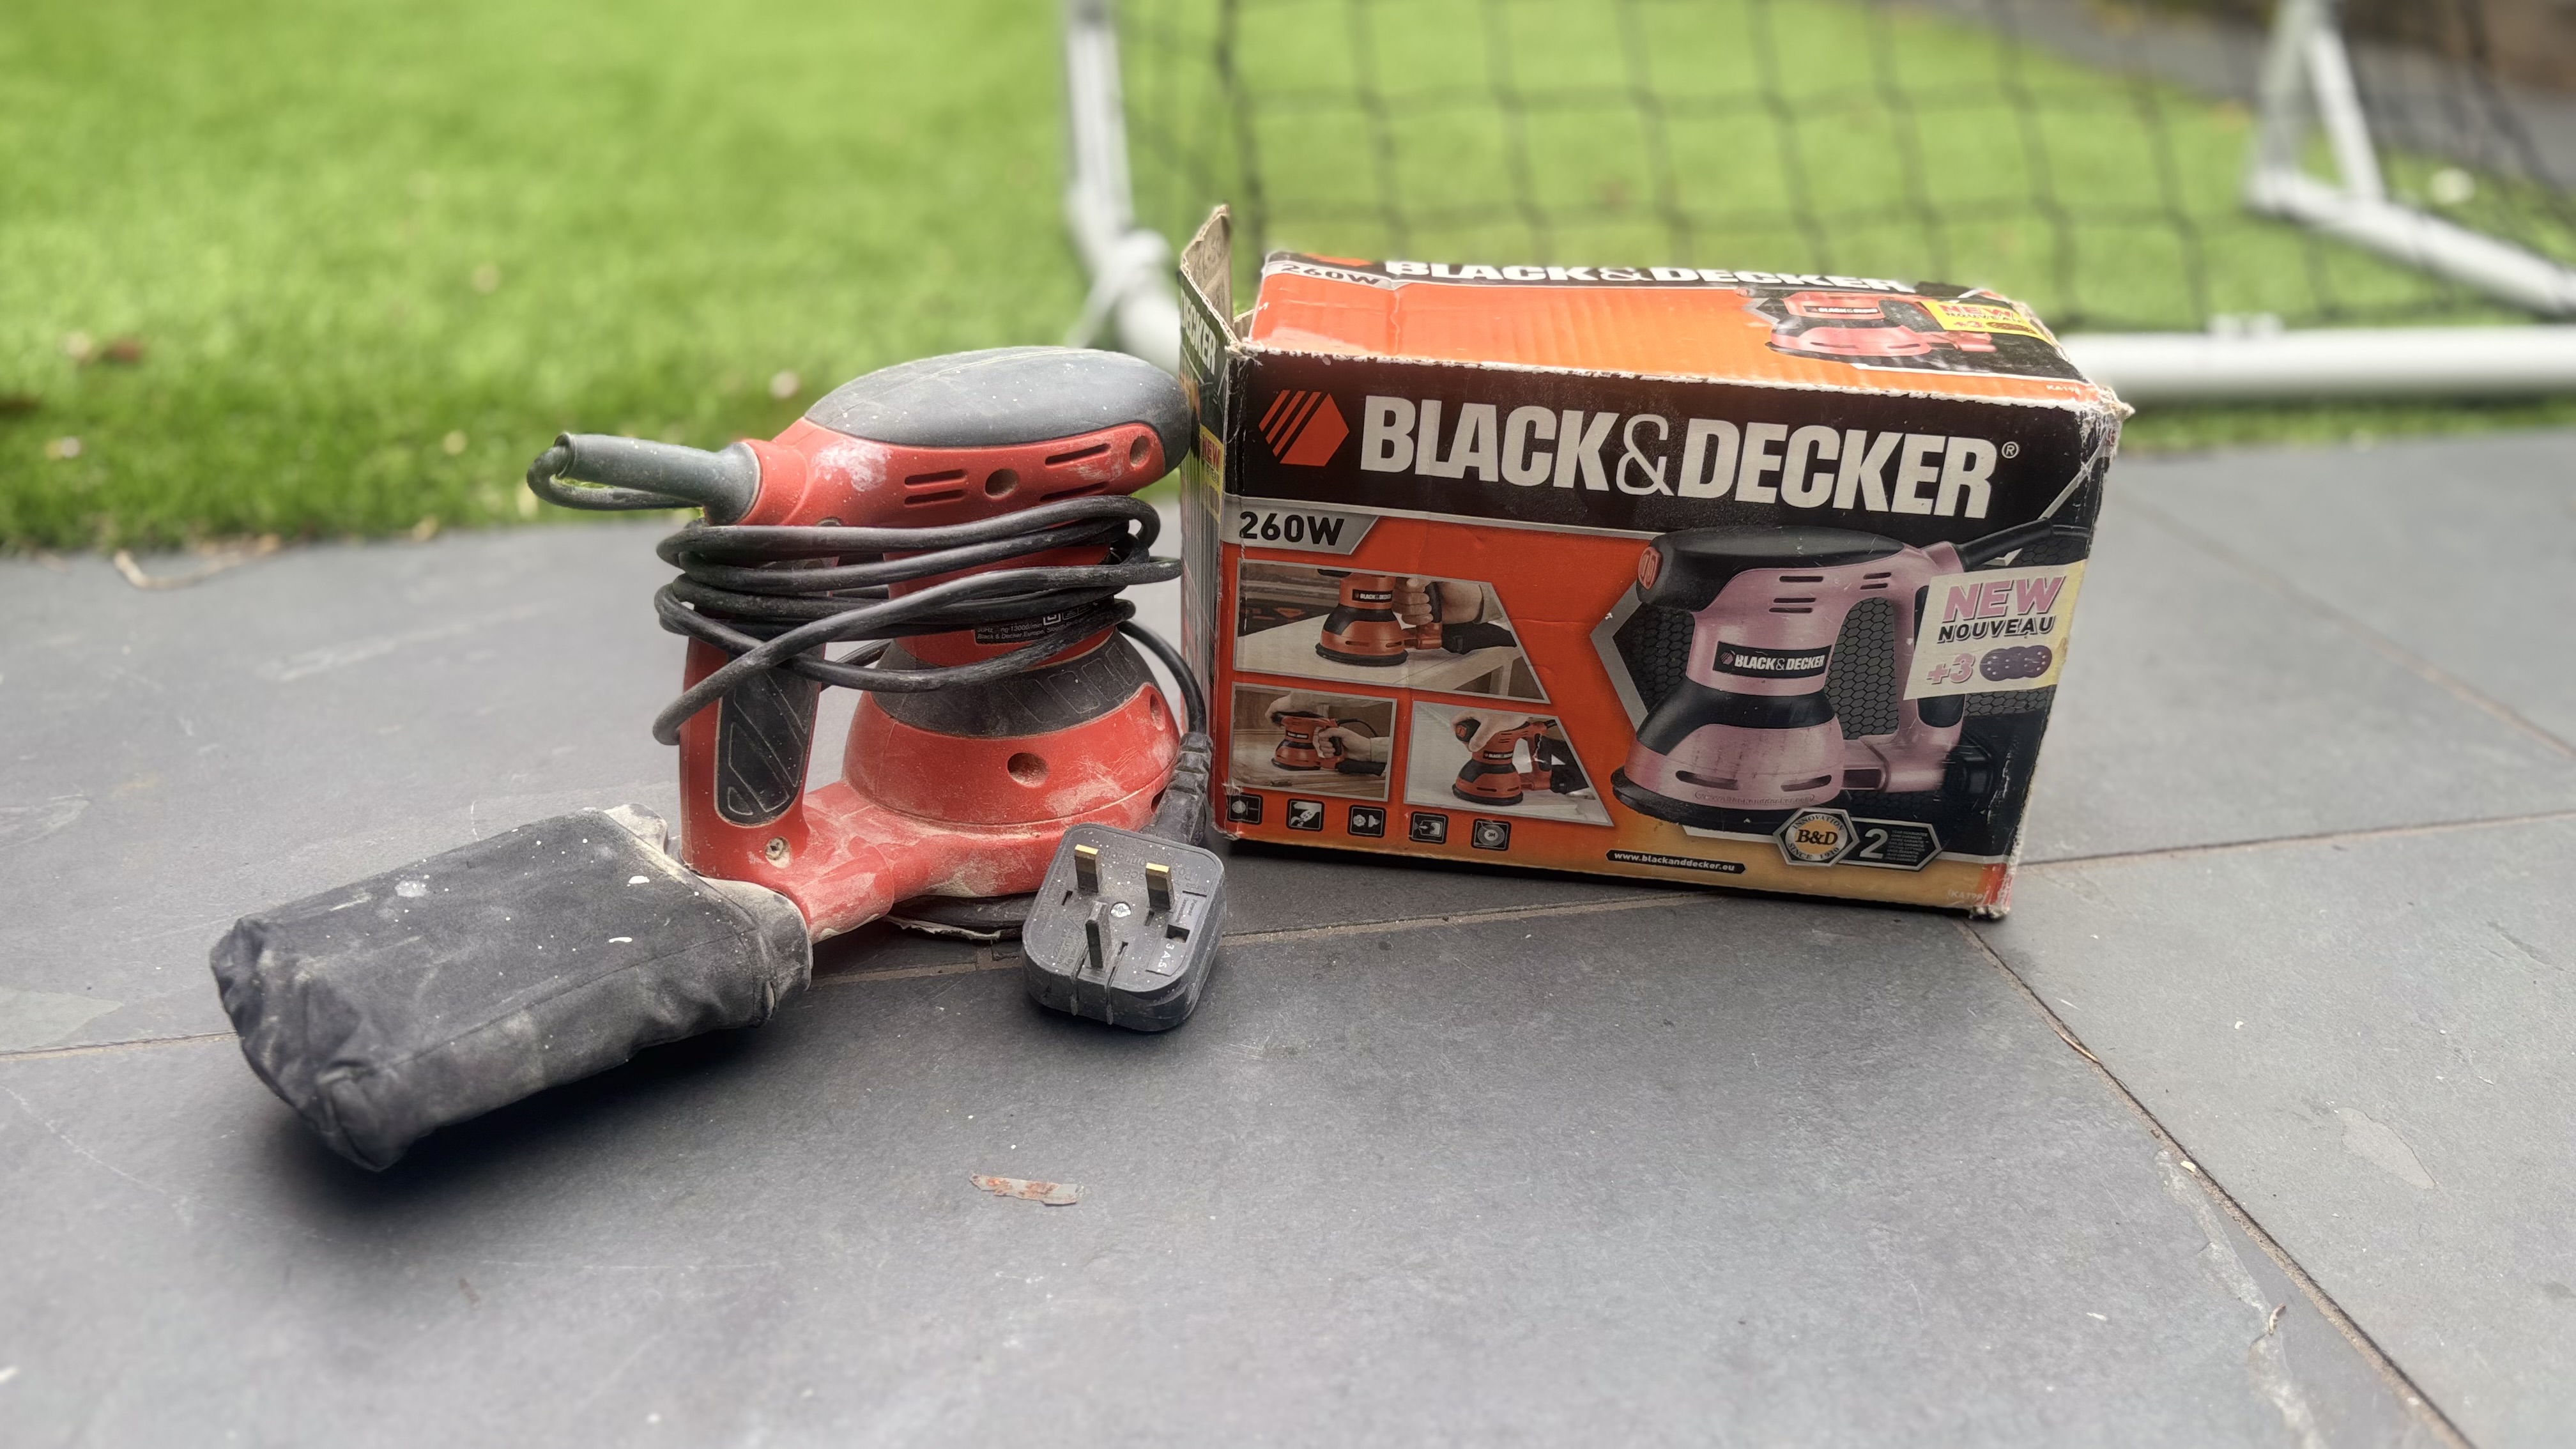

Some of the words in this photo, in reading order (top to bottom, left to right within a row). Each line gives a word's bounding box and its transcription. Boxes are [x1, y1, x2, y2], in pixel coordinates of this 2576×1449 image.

[1281, 264, 1380, 286] 260W
[1939, 305, 2013, 318] NEW
[1239, 511, 1345, 546] 260W
[1942, 576, 2066, 624] NEW
[1937, 615, 2057, 644] NOUVEAU
[1735, 654, 1825, 671] BLACK&DECKER
[1927, 653, 1976, 685] +3
[1792, 815, 1844, 831] INNOVATION
[1795, 829, 1838, 845] B&D
[1859, 828, 1888, 859] 2
[1789, 843, 1813, 860] SINCE
[1820, 847, 1840, 859] 1910
[1614, 852, 1735, 871] www.blackanddecker.eu
